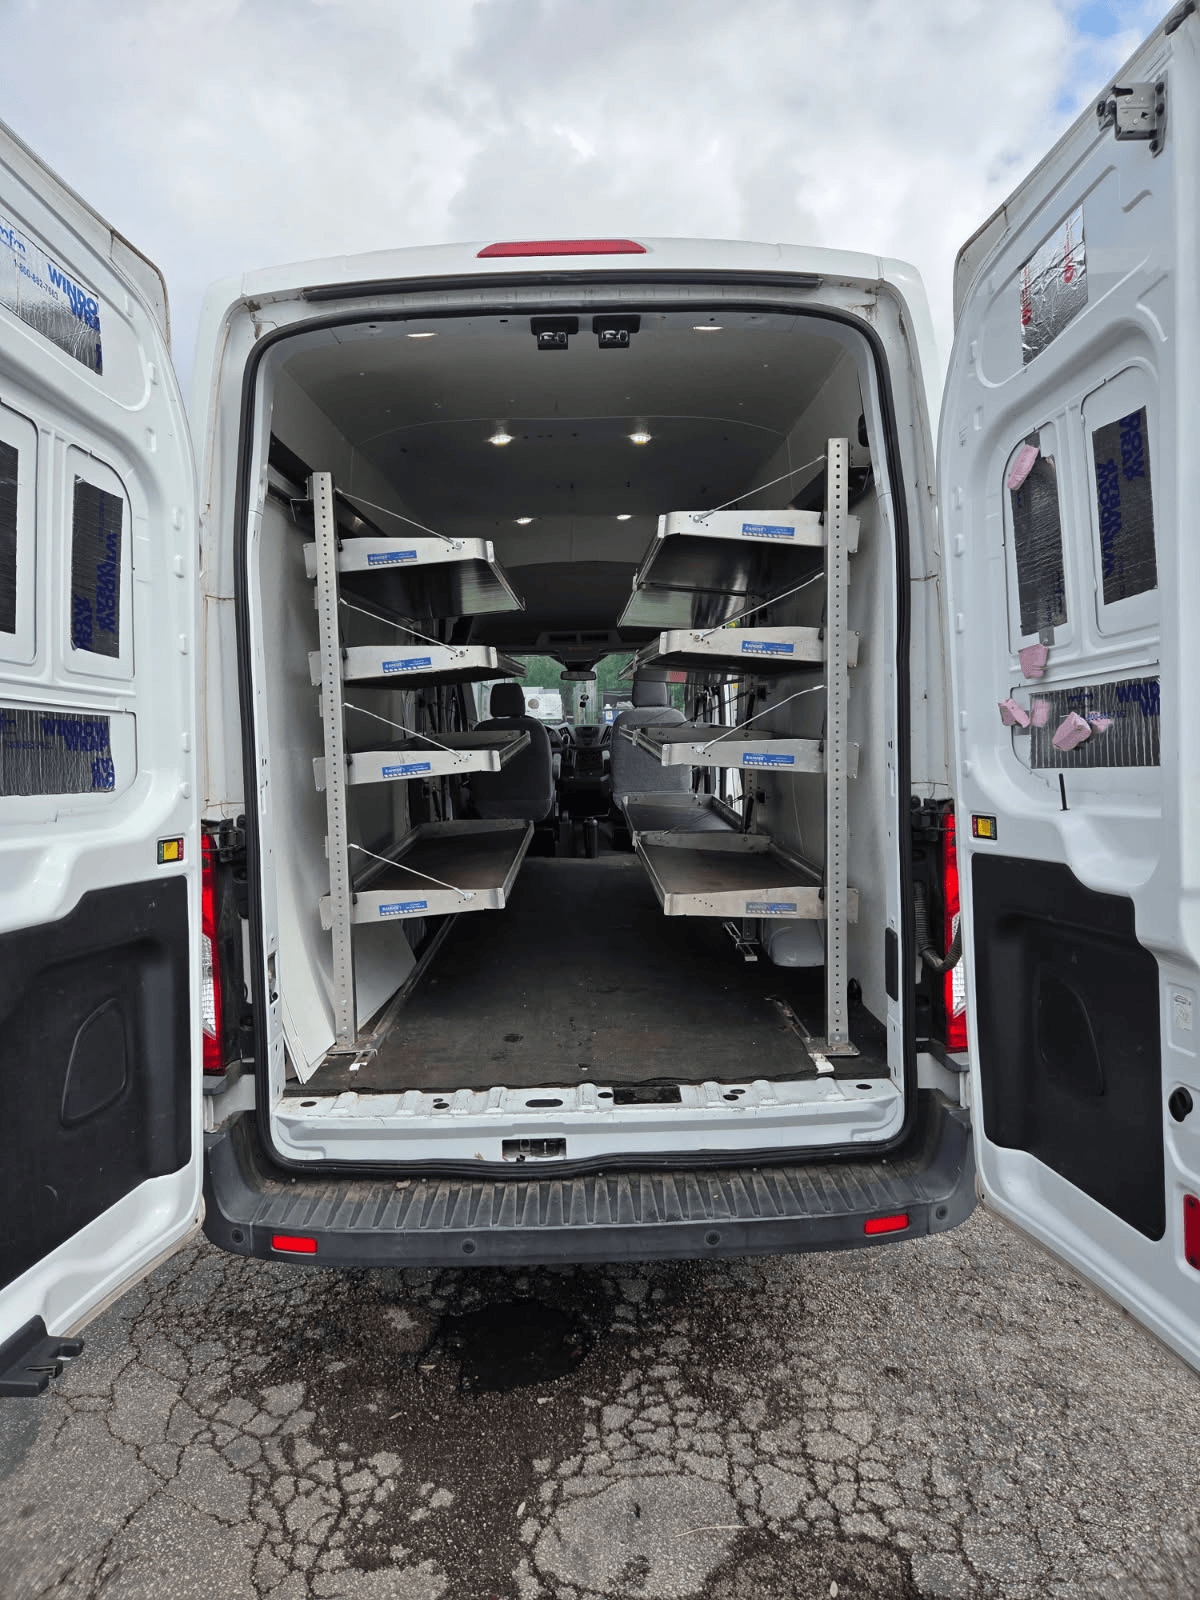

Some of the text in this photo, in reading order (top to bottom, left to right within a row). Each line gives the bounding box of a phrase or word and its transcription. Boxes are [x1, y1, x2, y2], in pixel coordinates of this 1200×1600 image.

[1097, 463, 1116, 577] WINDOW
[1106, 459, 1122, 533] WRAP
[105, 533, 118, 634] WINDOW
[41, 719, 109, 738] WINDOW
